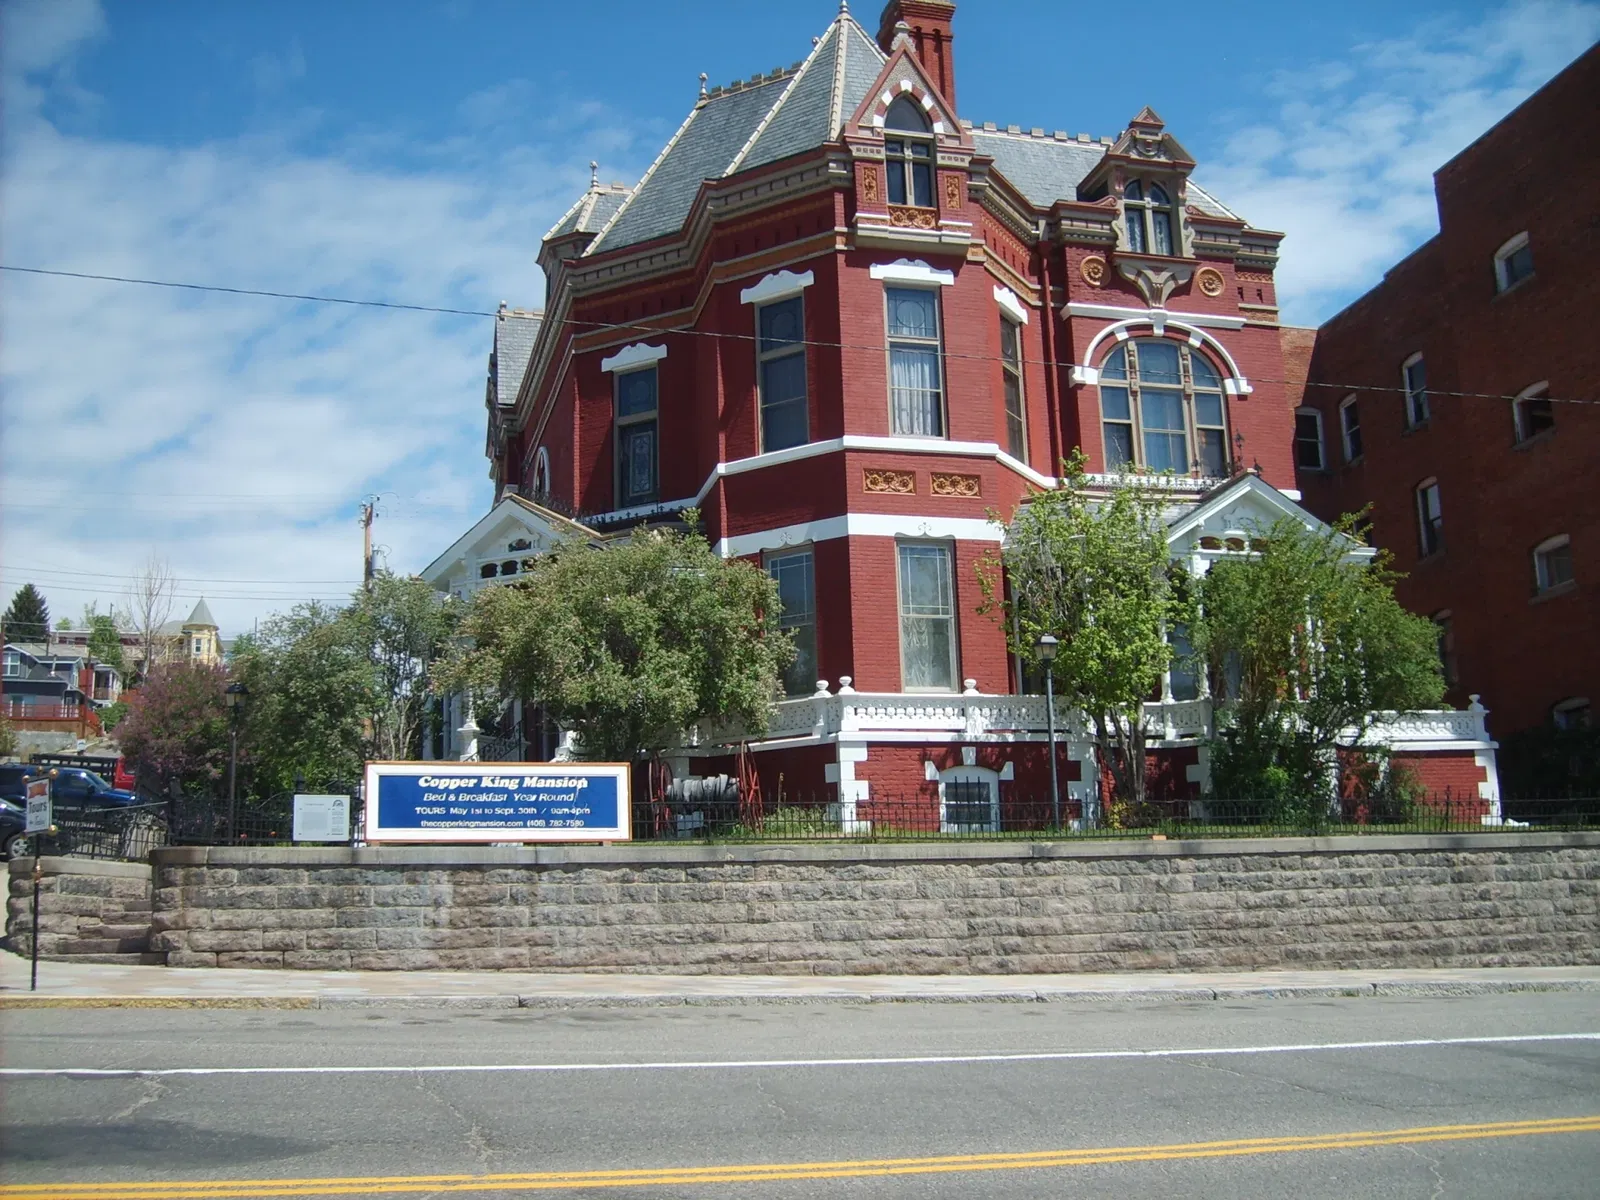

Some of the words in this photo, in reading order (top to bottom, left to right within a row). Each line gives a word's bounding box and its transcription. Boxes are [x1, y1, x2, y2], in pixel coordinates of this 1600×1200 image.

[418, 776, 478, 789] Copper
[480, 776, 520, 790] King
[522, 776, 588, 789] Mansion
[423, 793, 447, 801] Bed
[448, 793, 455, 801] &
[458, 793, 508, 801] Breakfast
[514, 793, 537, 801] Year
[538, 793, 574, 801] Round
[28, 802, 47, 814] Tours
[450, 807, 468, 815] May
[494, 807, 515, 815] Sept.
[550, 807, 590, 815] 9am-4pm
